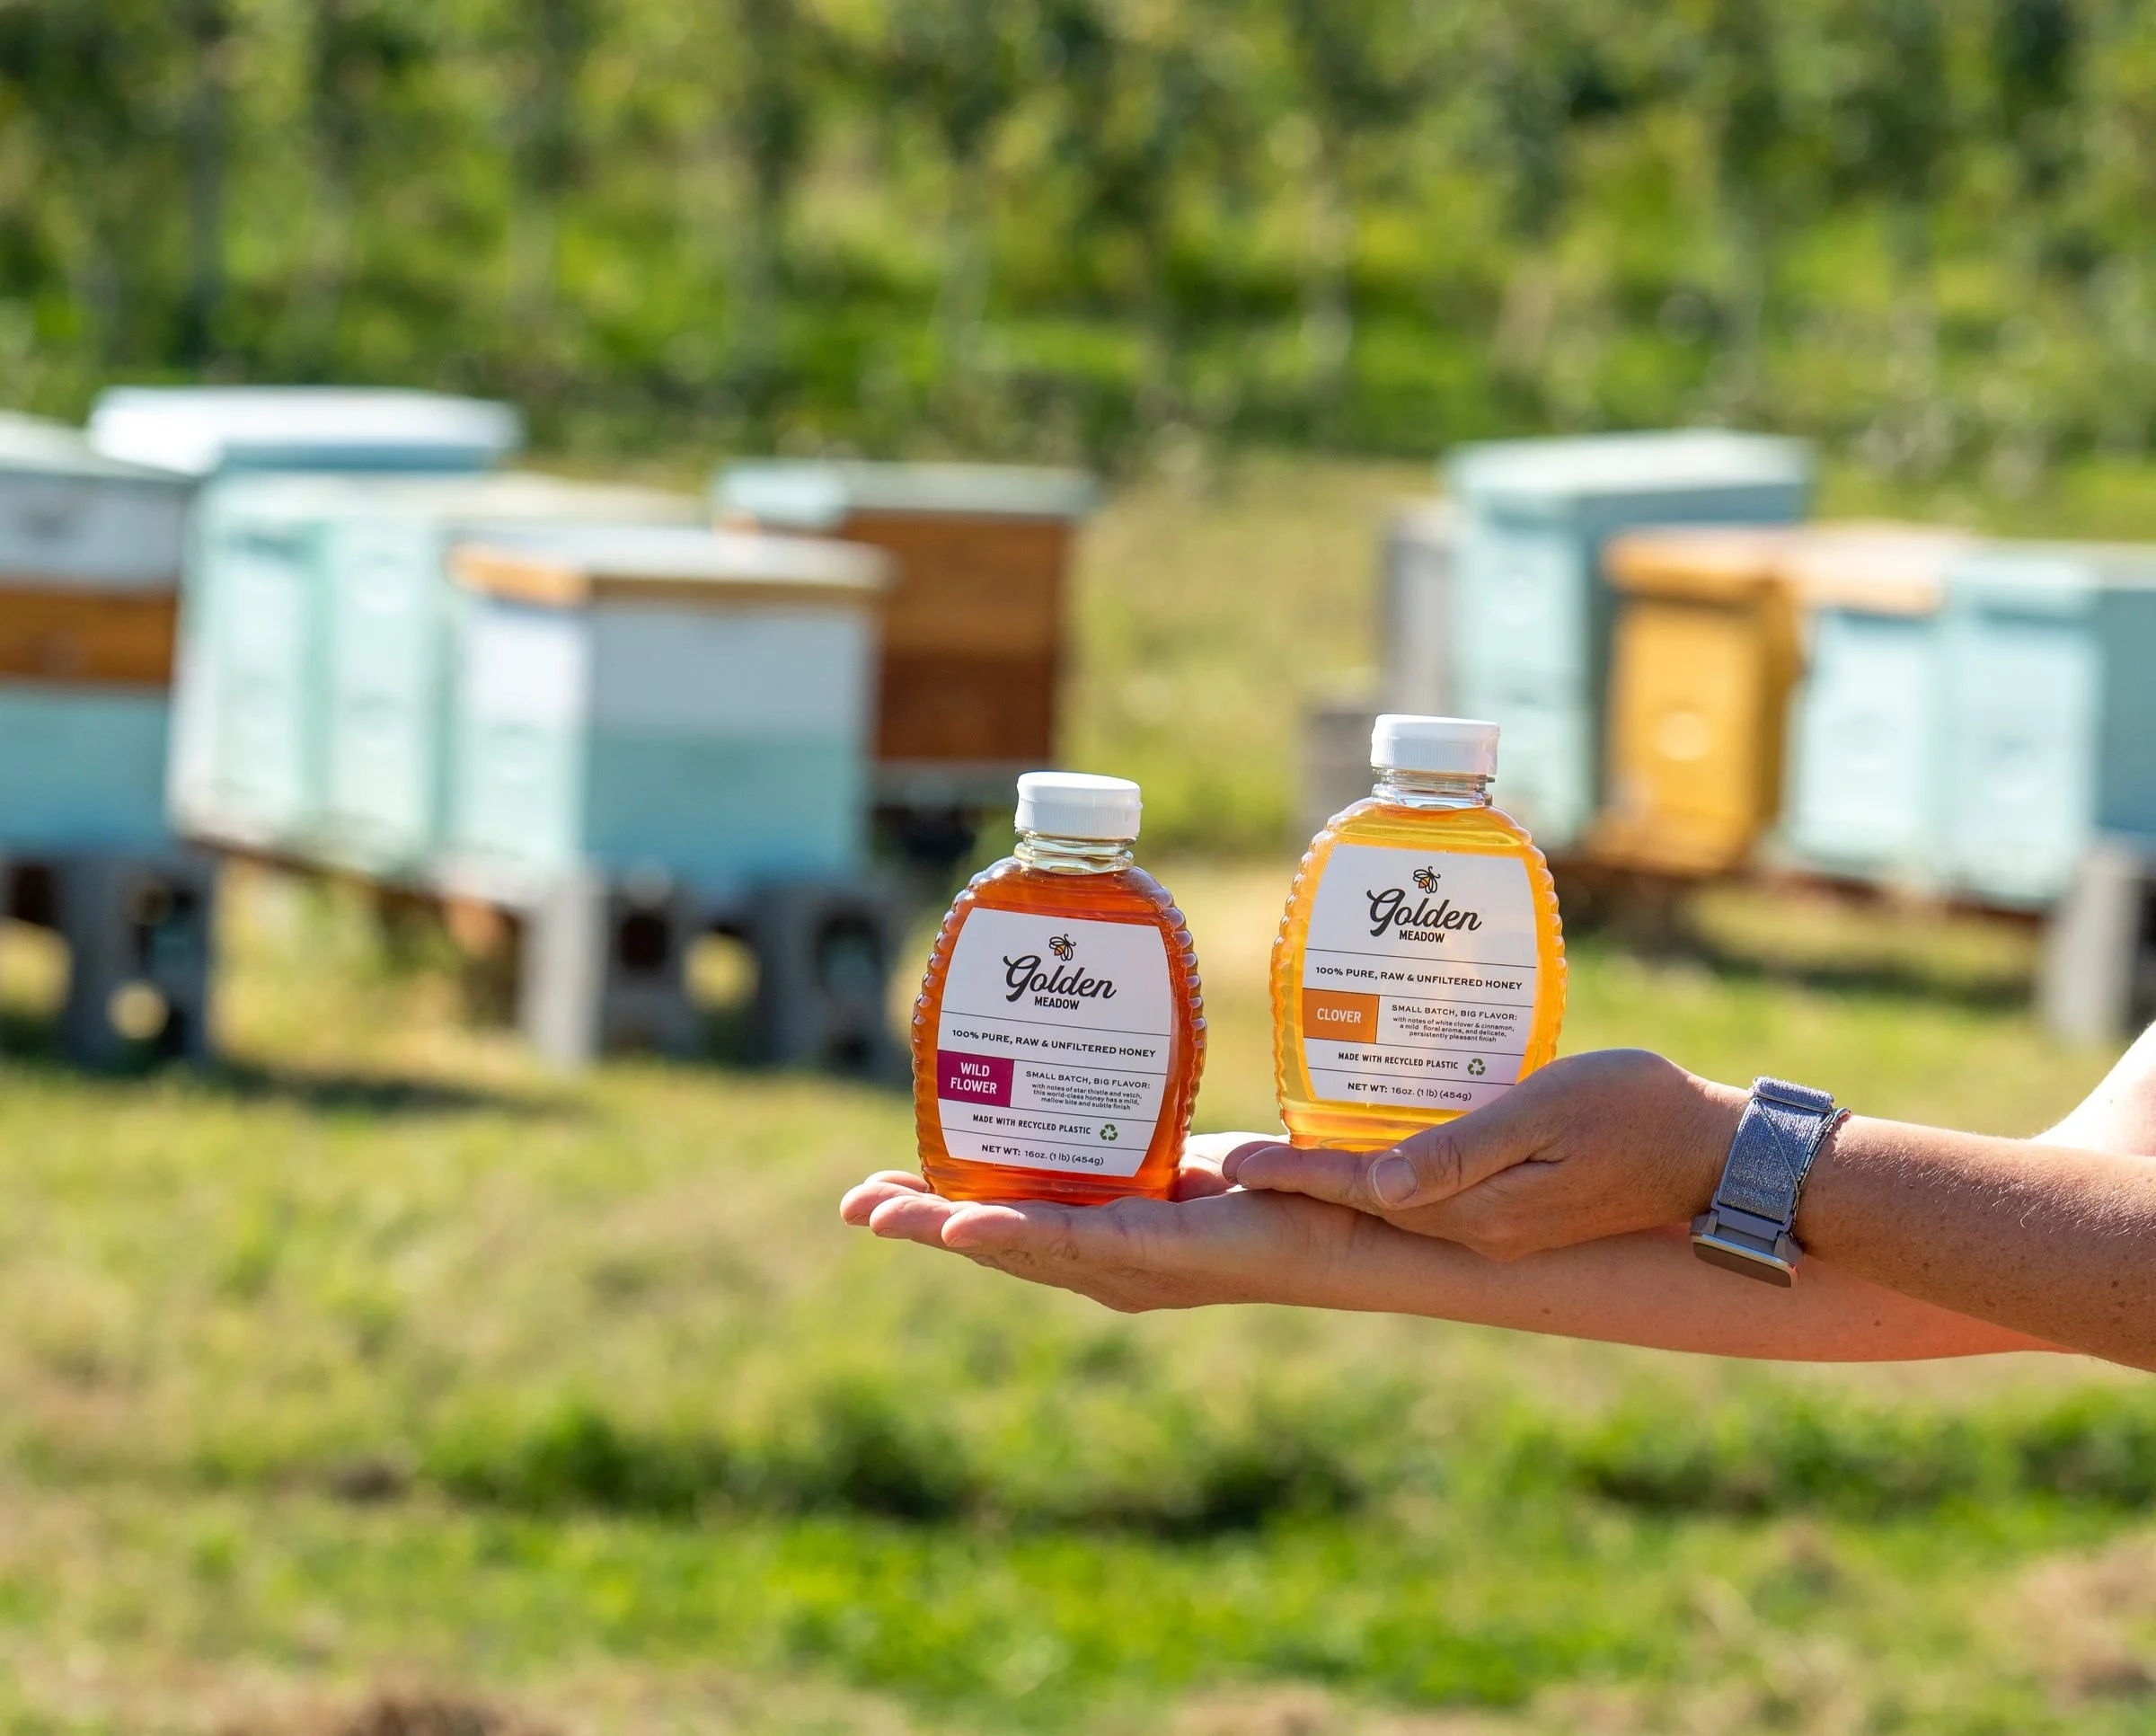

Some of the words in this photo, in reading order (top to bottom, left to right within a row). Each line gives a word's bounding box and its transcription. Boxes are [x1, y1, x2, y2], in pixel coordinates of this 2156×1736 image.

[1366, 888, 1482, 936] Golden
[1399, 930, 1445, 943] MEADOW
[1003, 955, 1117, 1002] Golden
[1316, 967, 1343, 976] 100%
[1346, 969, 1378, 979] PURE,
[1380, 971, 1404, 981] RAW
[1417, 974, 1482, 987] UNFILTERED
[1485, 980, 1523, 989] HONEY
[1034, 996, 1080, 1010] MEADOW
[1317, 1008, 1361, 1023] CLOVER
[1392, 1005, 1422, 1013] SMALL
[1425, 1007, 1457, 1017] BATCH,
[1479, 1012, 1517, 1021] FLAVOR:
[952, 1030, 979, 1040] 100%
[982, 1032, 1013, 1044] PURE,
[1015, 1037, 1039, 1047] RAW
[1051, 1041, 1117, 1054] UNFILTERED
[1118, 1047, 1156, 1058] HONEY
[1409, 1032, 1448, 1040] persistently
[960, 1062, 990, 1076] WILD
[1339, 1052, 1359, 1060] MADE
[1362, 1055, 1382, 1063] WITH
[1385, 1057, 1423, 1067] RECYCLED
[1427, 1060, 1458, 1069] PLASTIC
[950, 1077, 997, 1094] FLOWER
[1026, 1071, 1056, 1080] SMALL
[1058, 1075, 1091, 1085] BATCH,
[1112, 1080, 1150, 1089] FLAVOR:
[1047, 1091, 1084, 1099] world-class
[1085, 1094, 1105, 1103] honey
[1348, 1083, 1367, 1091] NET
[1370, 1085, 1387, 1093] WT:
[1417, 1088, 1424, 1097] (1
[1427, 1089, 1437, 1098] lb)
[1439, 1090, 1471, 1101] (454g)
[973, 1114, 993, 1123] MADE
[996, 1117, 1015, 1126] WITH
[1018, 1120, 1056, 1130] RECYCLED
[1059, 1124, 1091, 1134] PLASTIC
[982, 1144, 1001, 1153] NET
[1003, 1147, 1021, 1156] WT:
[1025, 1151, 1047, 1159] 16oz.
[1050, 1153, 1056, 1161] (1
[1059, 1153, 1070, 1162] lb)
[1072, 1154, 1103, 1165] (454g)
